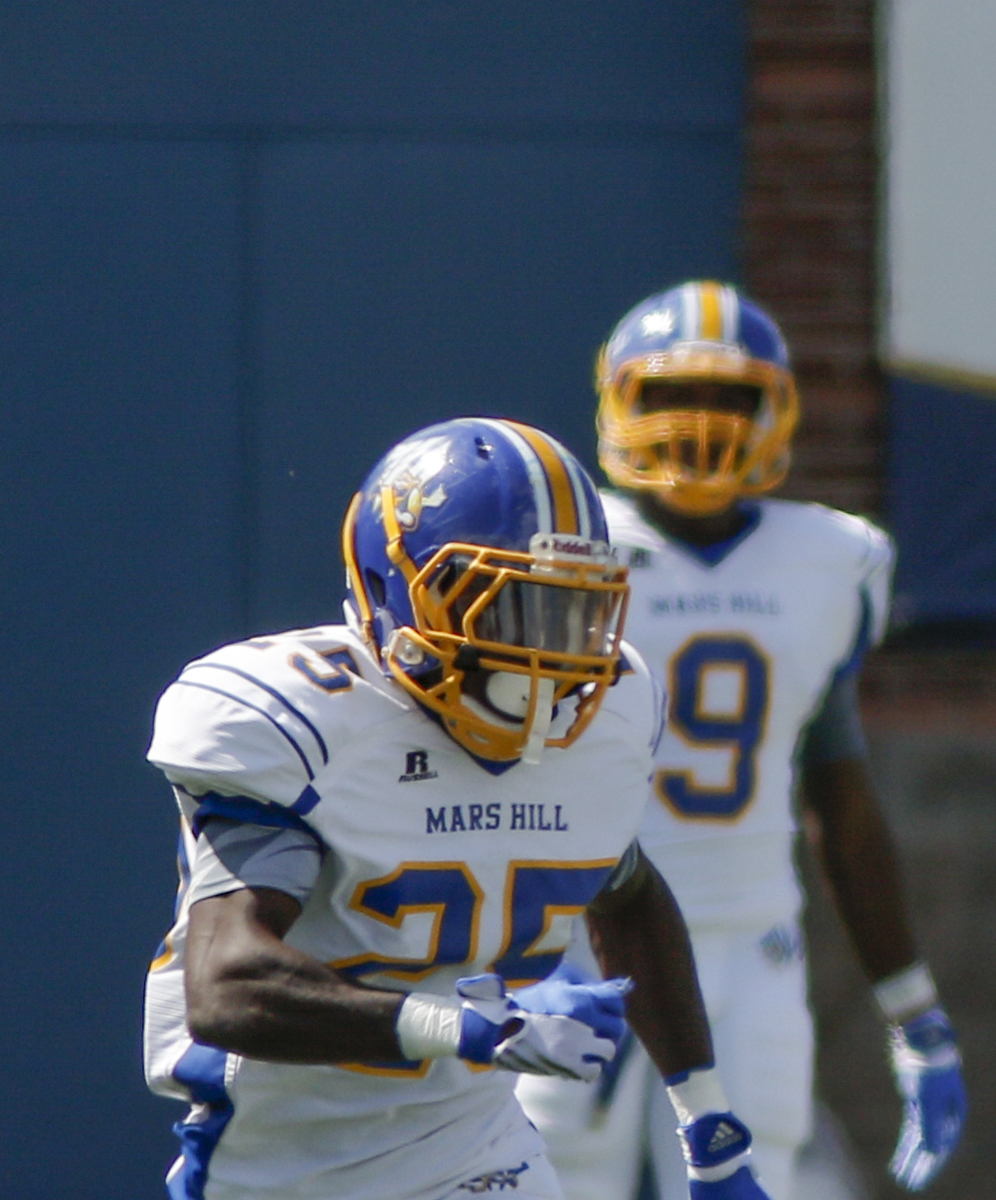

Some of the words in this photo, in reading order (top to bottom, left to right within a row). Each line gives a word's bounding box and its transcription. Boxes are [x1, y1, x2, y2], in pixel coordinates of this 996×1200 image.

[656, 630, 773, 825] 9
[425, 803, 501, 834] MARS
[509, 804, 569, 832] HILL
